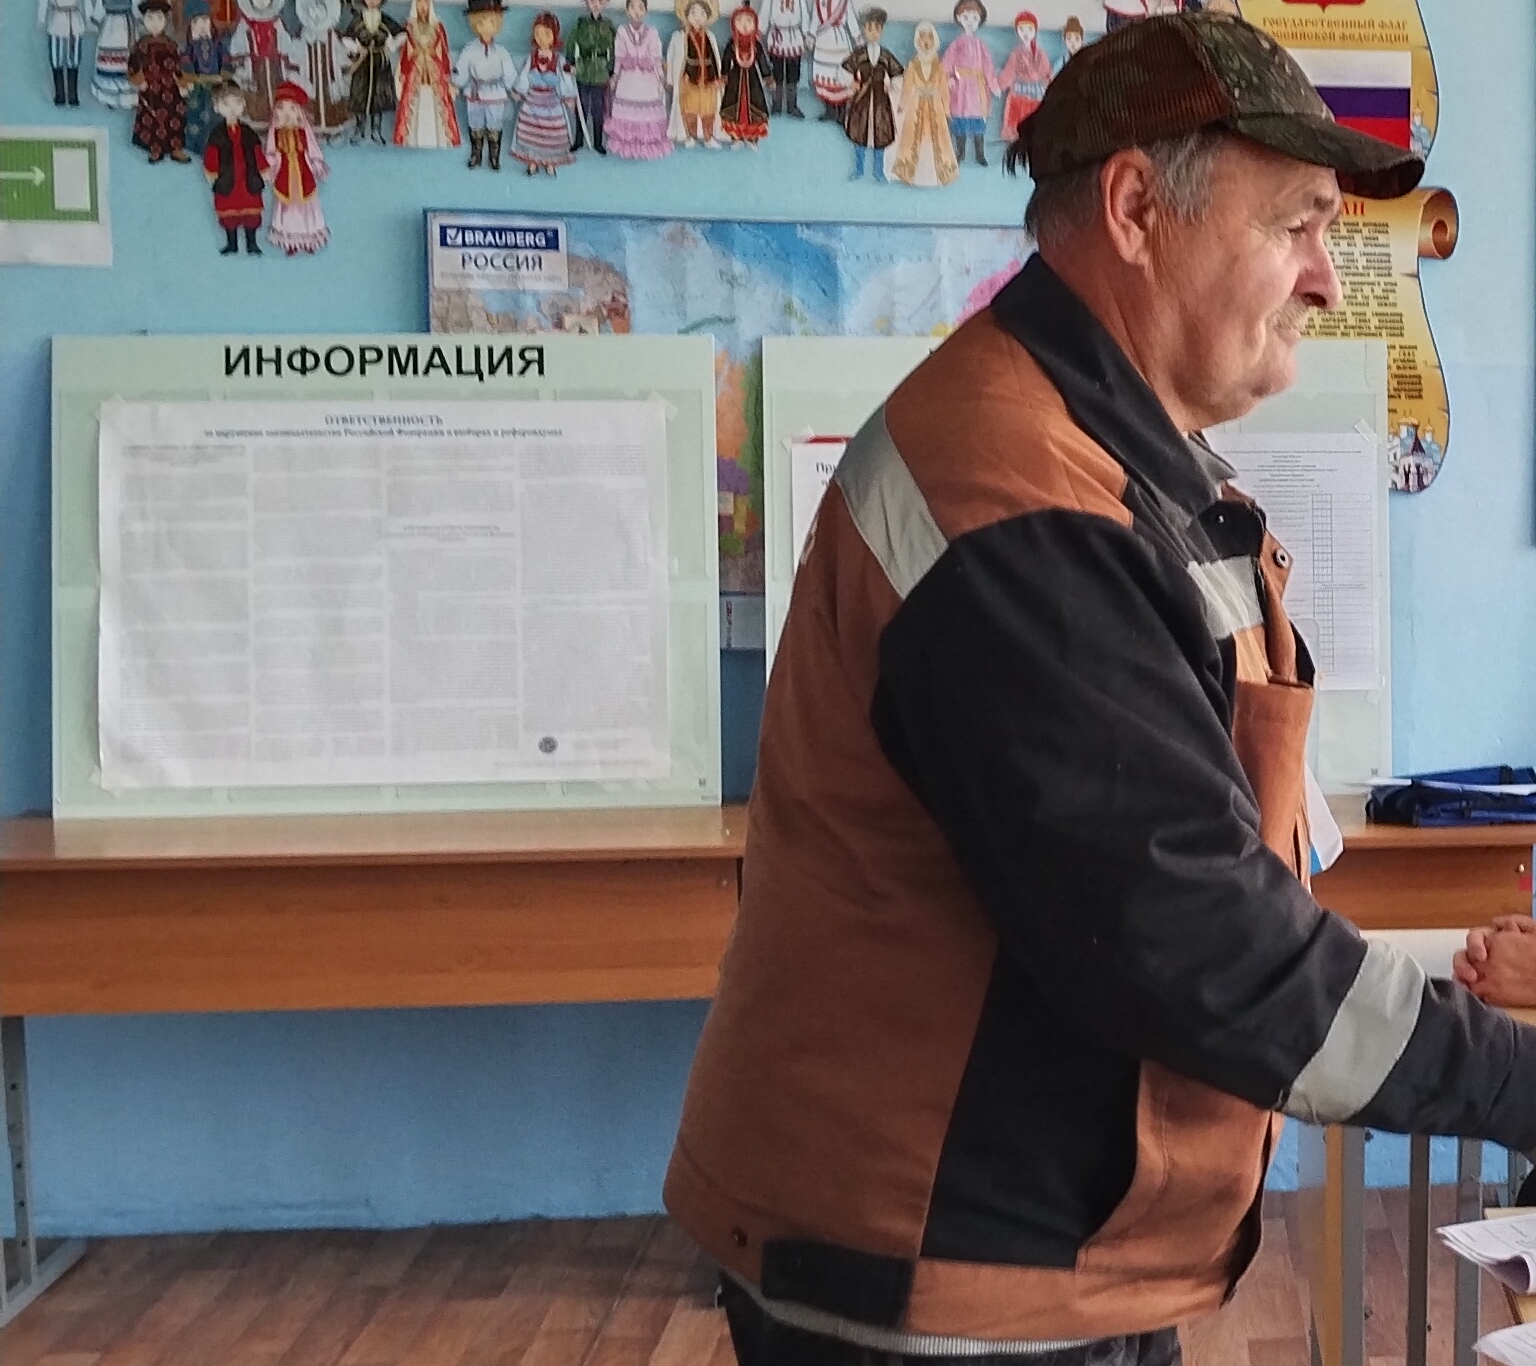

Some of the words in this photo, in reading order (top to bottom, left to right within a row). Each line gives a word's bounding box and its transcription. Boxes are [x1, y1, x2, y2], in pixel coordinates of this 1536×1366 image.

[464, 229, 546, 248] BRAUBERG
[461, 252, 543, 272] РОССИЯ
[224, 344, 546, 383] ИНФОРМАЦИЯ
